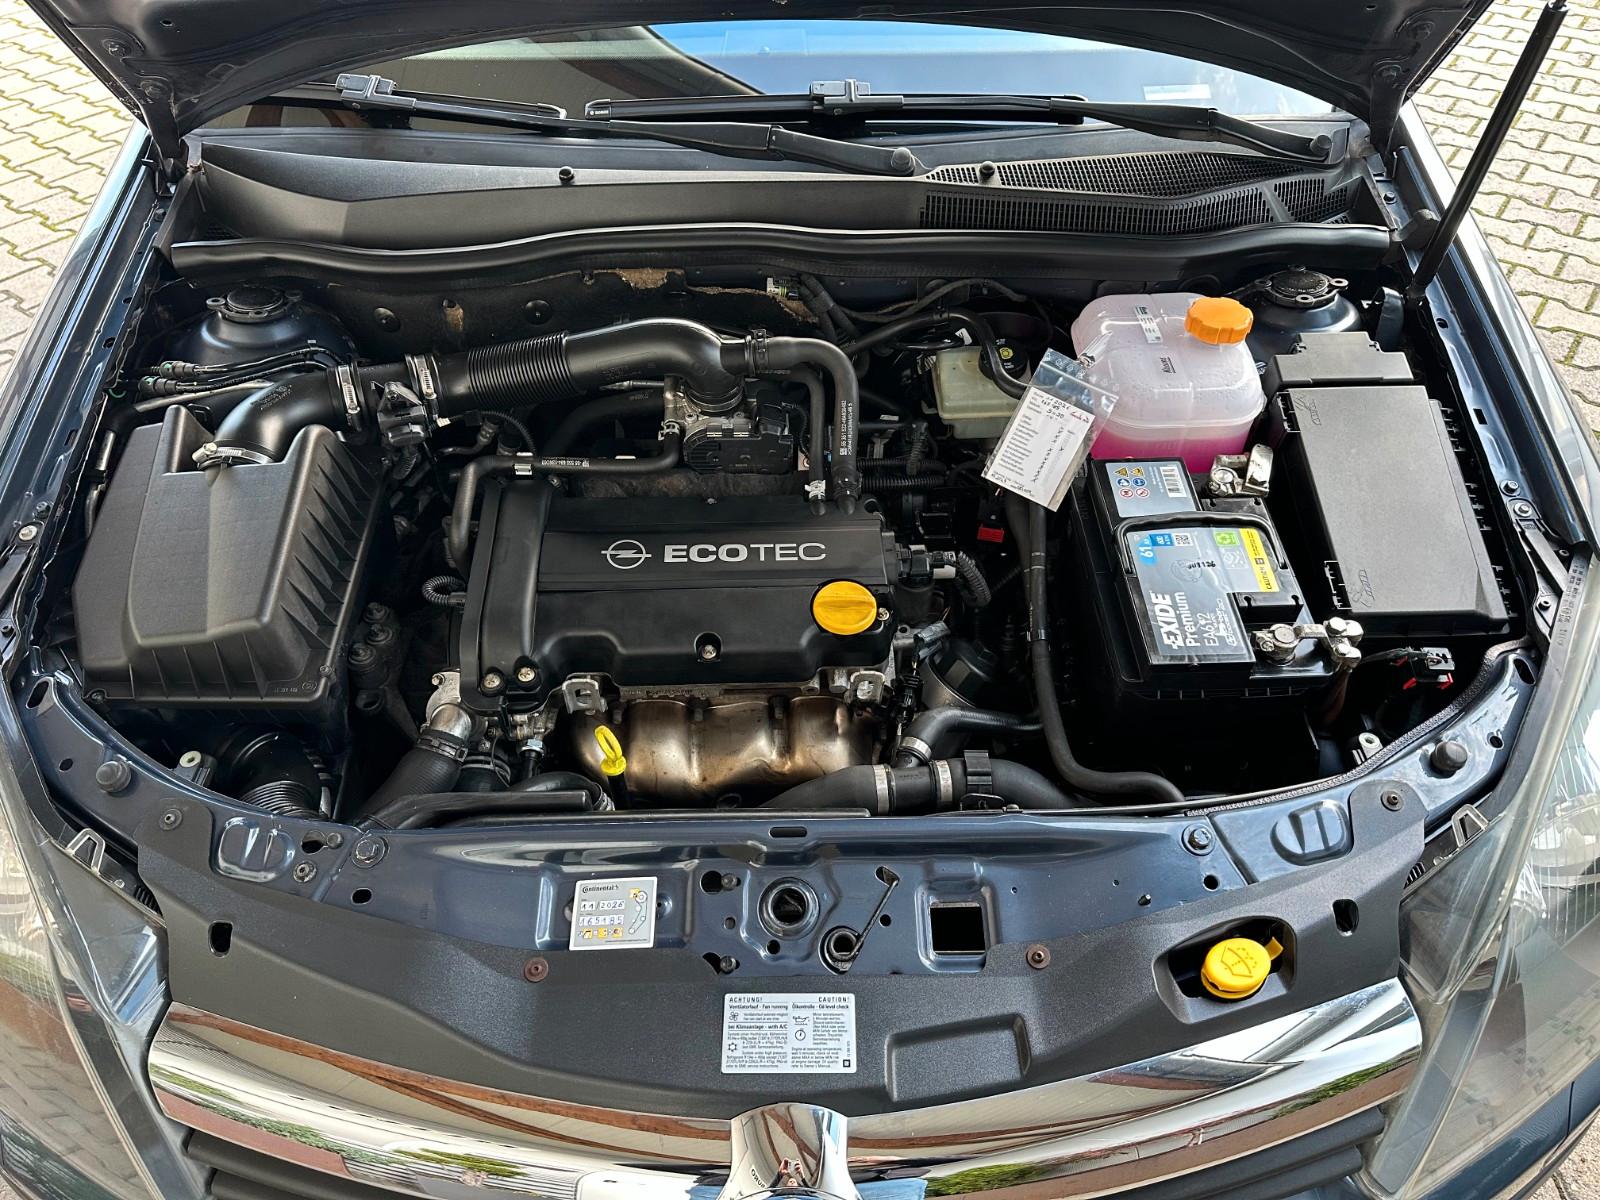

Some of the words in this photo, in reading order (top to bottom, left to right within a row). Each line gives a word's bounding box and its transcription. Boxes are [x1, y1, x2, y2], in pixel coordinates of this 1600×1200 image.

[663, 543, 826, 562] ECOTEC
[1151, 592, 1184, 649] EXIDE
[1176, 591, 1201, 647] Premium
[582, 885, 614, 894] Continental
